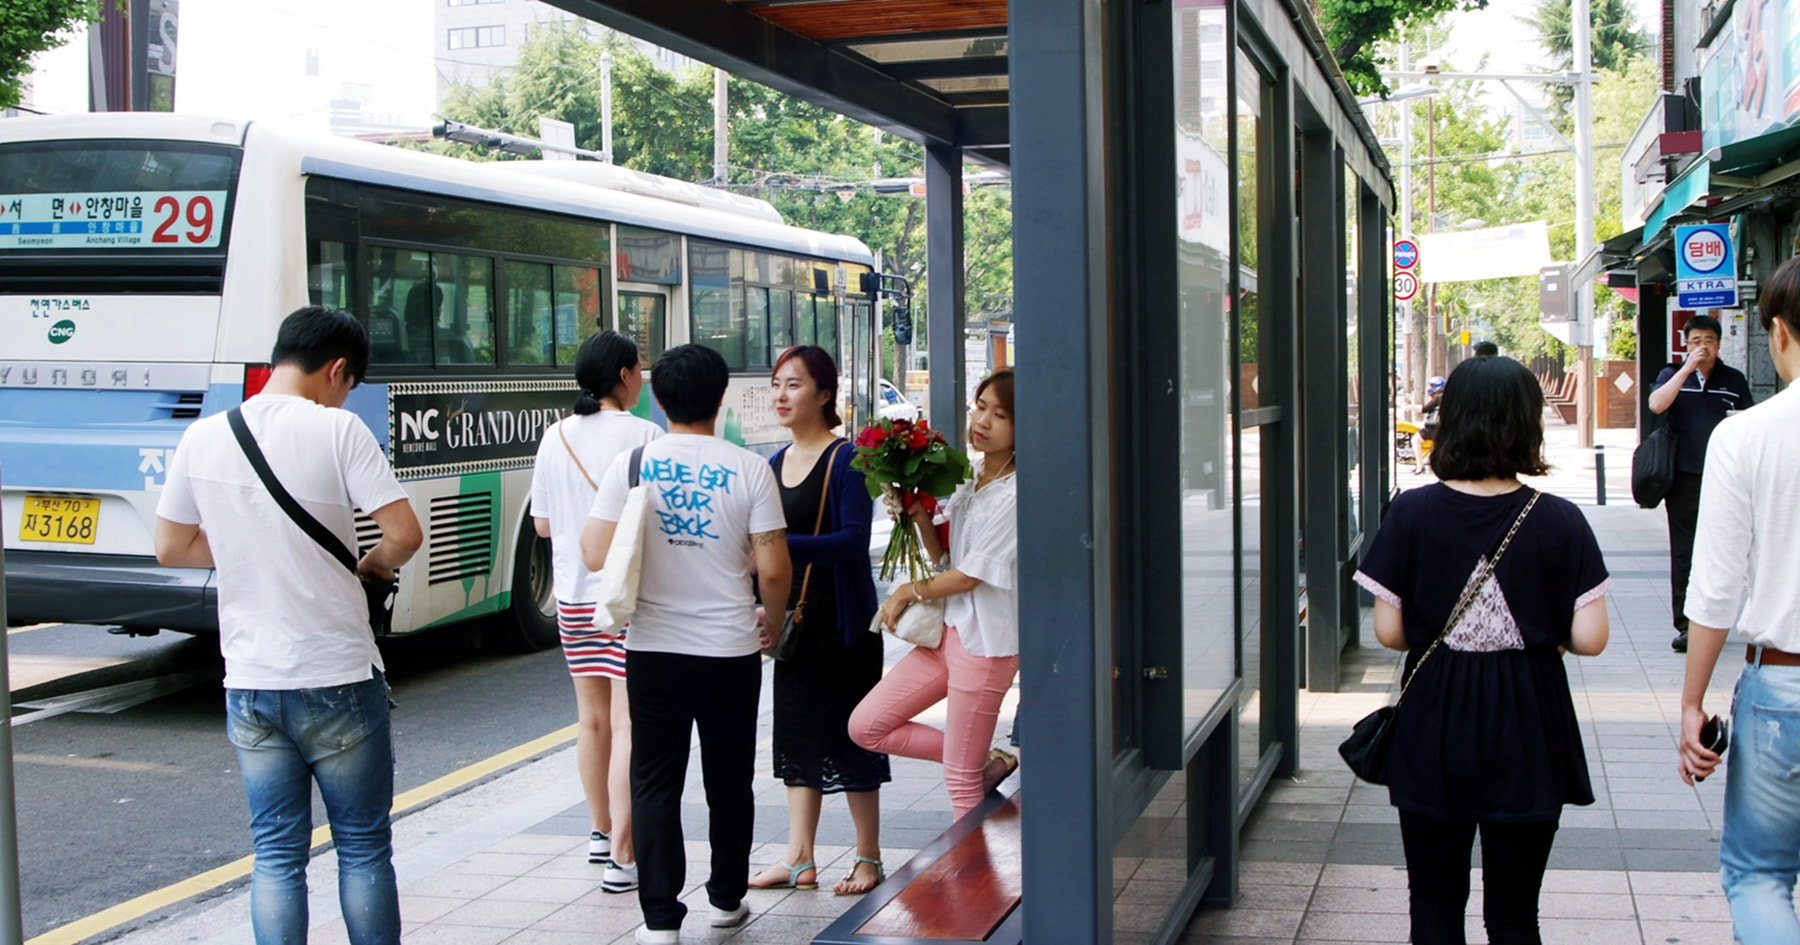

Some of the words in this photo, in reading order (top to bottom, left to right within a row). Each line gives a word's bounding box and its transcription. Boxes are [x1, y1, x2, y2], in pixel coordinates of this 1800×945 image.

[85, 196, 144, 219] 안창마을
[152, 195, 213, 244] 29
[86, 237, 115, 245] Anchang
[117, 236, 142, 244] Village
[1688, 241, 1722, 258] 담배
[1395, 278, 1412, 293] 30
[1687, 281, 1725, 290] KTRA
[30, 299, 90, 318] 천연가스버스
[50, 327, 74, 337] CNG
[401, 408, 440, 441] NC
[446, 409, 515, 449] GRAND
[698, 463, 737, 494] GOT
[42, 499, 60, 512] 부산
[64, 500, 81, 513] 70
[658, 484, 714, 514] YOUR
[39, 514, 93, 539] 3168
[656, 509, 720, 539] BACK
